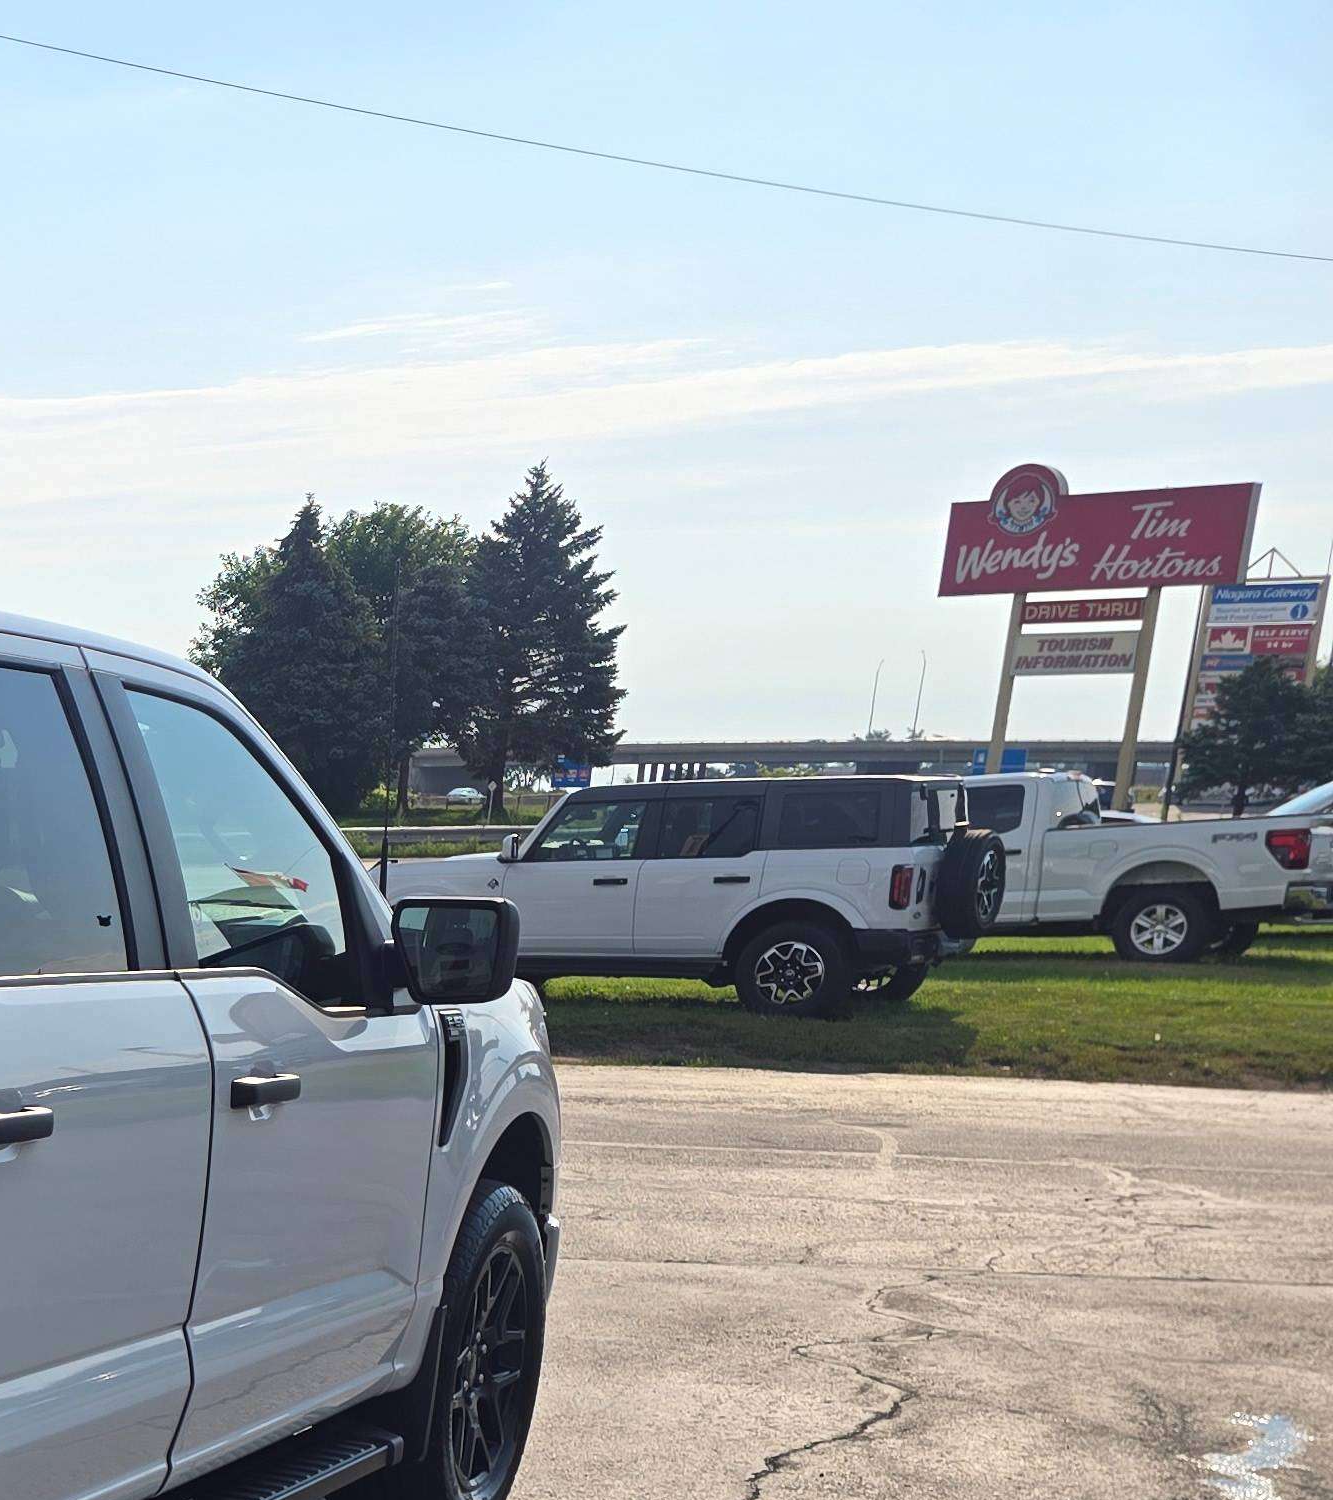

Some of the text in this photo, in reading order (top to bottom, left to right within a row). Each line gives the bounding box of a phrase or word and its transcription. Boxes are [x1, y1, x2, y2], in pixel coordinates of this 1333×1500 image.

[1130, 501, 1191, 539] Tim
[954, 531, 1080, 584] Wendy's
[1090, 543, 1223, 582] Hortons
[1215, 586, 1316, 601] Niagara Gateway
[1025, 600, 1138, 620] DRIVE THRU
[1254, 628, 1309, 637] SELF SERVE
[1036, 637, 1114, 653] TOURISM
[1014, 652, 1133, 670] INFORMATION
